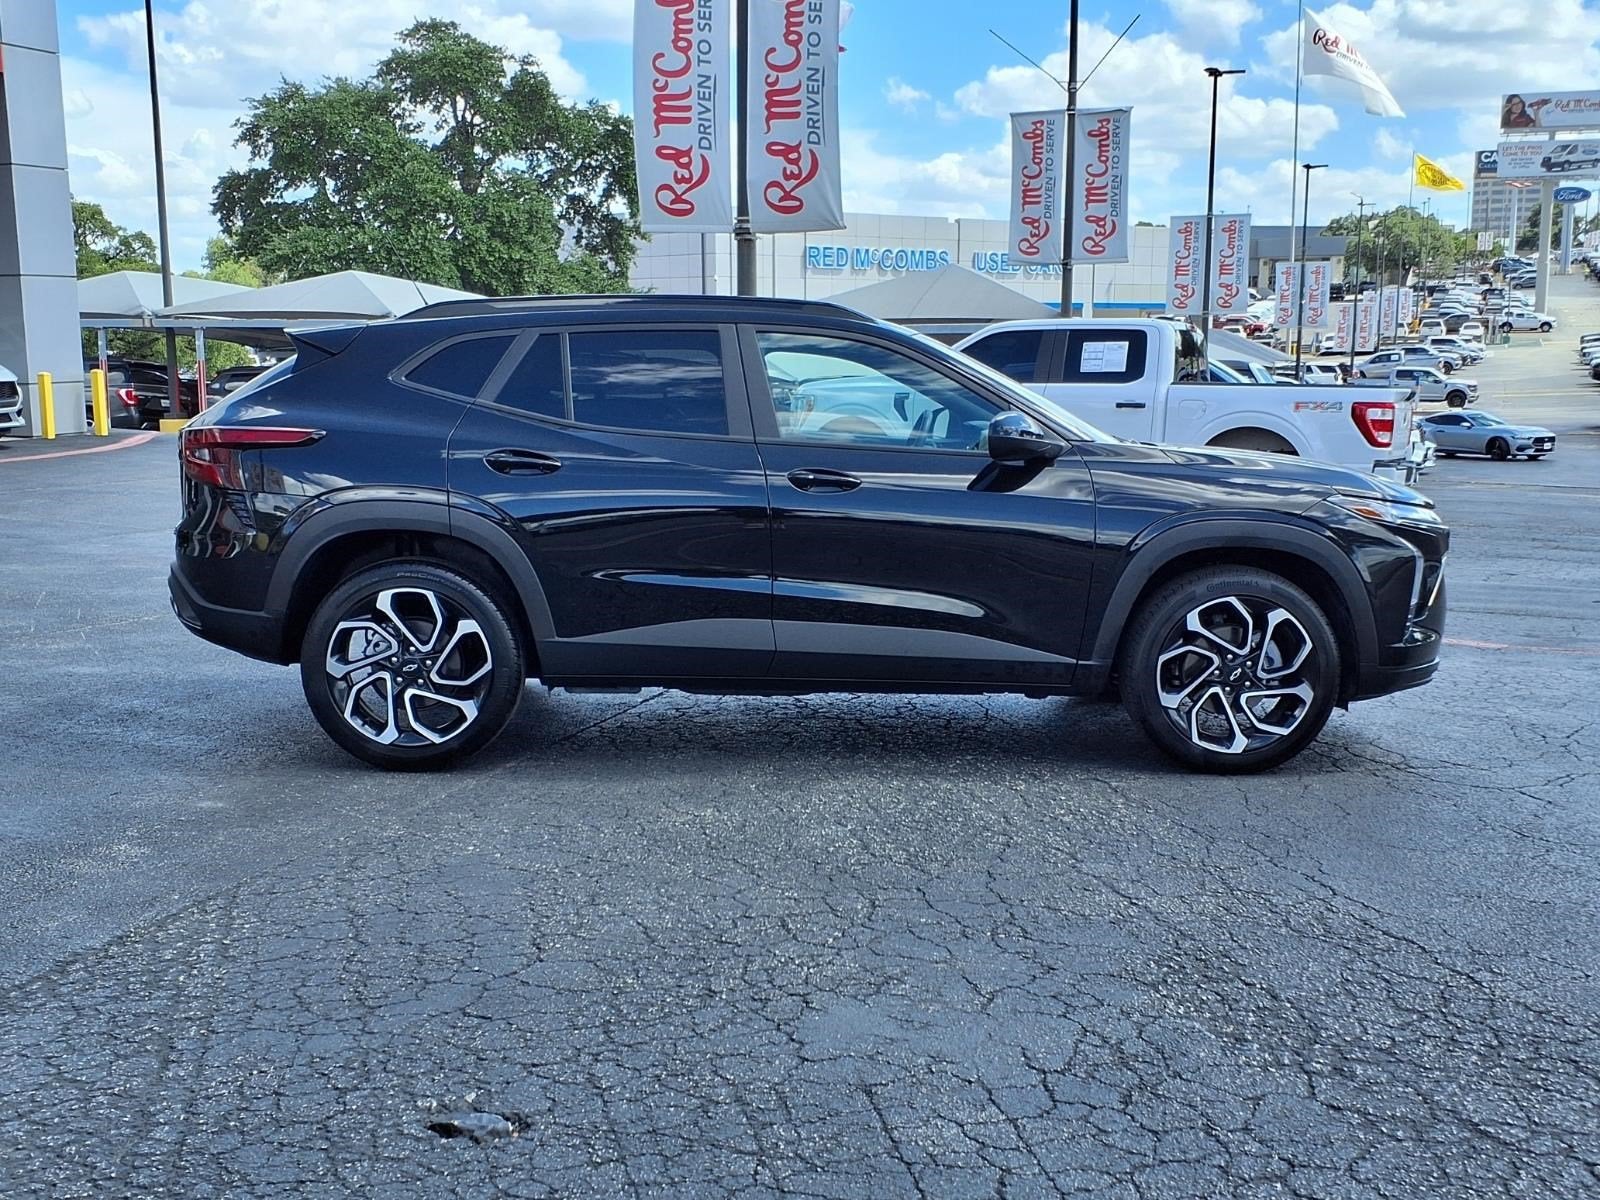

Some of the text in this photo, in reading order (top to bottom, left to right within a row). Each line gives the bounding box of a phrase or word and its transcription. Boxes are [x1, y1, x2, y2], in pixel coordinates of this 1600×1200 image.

[697, 0, 712, 151] DRIVEN TO SER
[807, 36, 821, 60] TO
[1312, 28, 1340, 53] Red
[652, 0, 710, 217] Red McCom
[764, 0, 819, 215] Red McCom
[807, 67, 821, 145] DRIVEN
[1021, 119, 1045, 213] McCombs
[1044, 119, 1056, 219] DRIVEN TO SERVE
[1082, 118, 1117, 255] Red McCombs
[1110, 117, 1121, 217] DRIVEN TO SERVE
[1558, 189, 1584, 200] Ford
[807, 246, 949, 270] RED McCOMBS
[1018, 216, 1050, 256] Red
[1172, 221, 1195, 309] Red McCombs
[1216, 219, 1239, 308] Red McCombs
[1293, 401, 1343, 412] FX4
